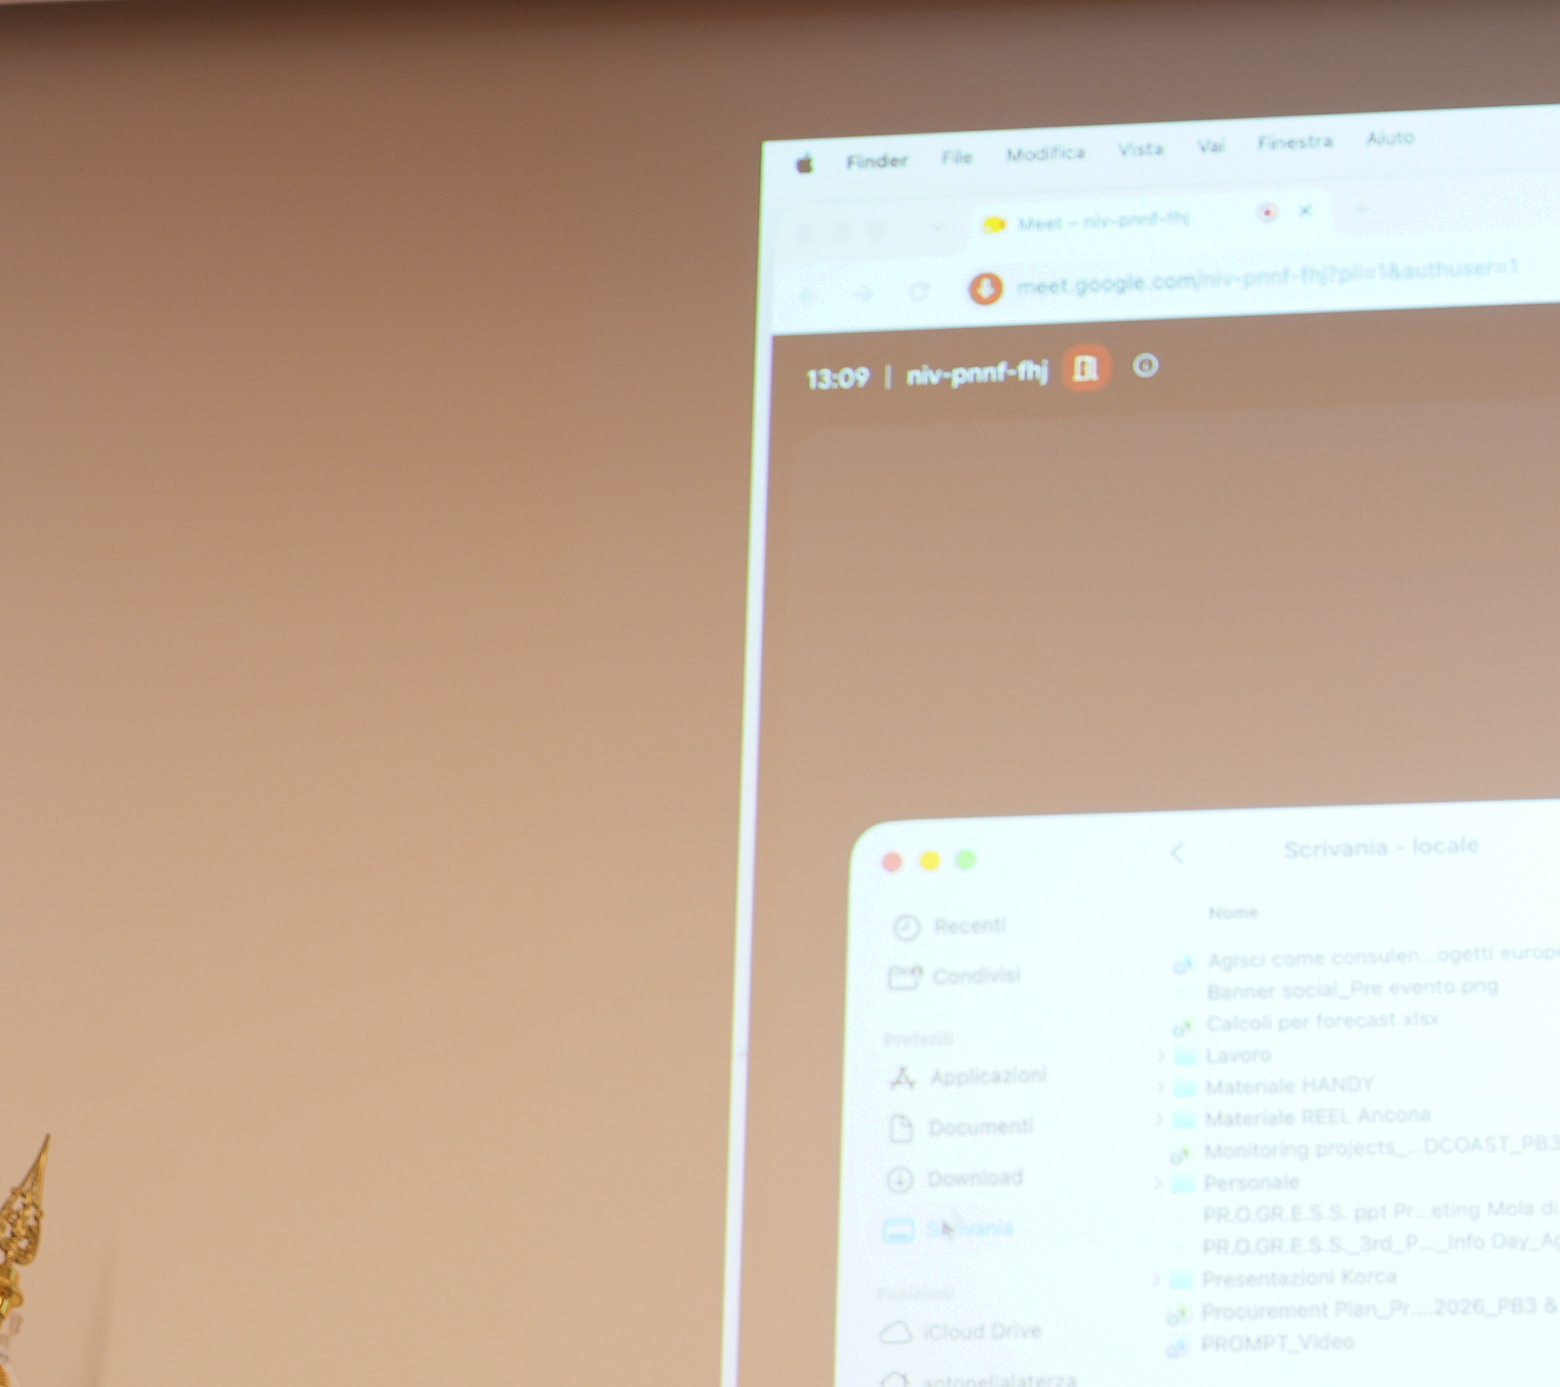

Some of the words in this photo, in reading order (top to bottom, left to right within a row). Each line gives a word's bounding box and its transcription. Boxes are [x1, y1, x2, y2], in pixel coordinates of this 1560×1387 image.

[845, 150, 910, 171] Finder
[940, 148, 974, 167] File
[1005, 142, 1087, 164] Modifica
[1117, 139, 1165, 159] Vista
[1196, 136, 1226, 156] Vai
[1256, 132, 1335, 153] Finestra
[1365, 128, 1416, 148] Aiuto
[806, 365, 870, 391] 13:09
[906, 359, 1050, 388] niv-pnnf-fhj
[1284, 838, 1389, 860] Scrivania
[1411, 835, 1480, 856] locale
[1207, 980, 1276, 1001] Banner
[1282, 977, 1381, 1001] social_Pre
[1386, 975, 1500, 1000] evento.png
[1206, 1011, 1274, 1034] Calcoli
[1281, 1014, 1313, 1034] per
[1319, 1008, 1440, 1031] forecast.xlsx
[1205, 1044, 1272, 1066] Lavoro
[929, 1064, 1048, 1090] Applicazioni
[1205, 1075, 1294, 1098] Materiale
[1300, 1073, 1375, 1095] HANDY
[927, 1115, 1034, 1139] Documenti
[1205, 1108, 1294, 1129] Materiale
[1299, 1106, 1351, 1127] REEL
[1357, 1104, 1432, 1126] Ancona
[927, 1166, 1024, 1190] Download
[1203, 1170, 1300, 1194] Personale
[1202, 1266, 1333, 1291] Presentazioni
[1338, 1266, 1398, 1288] Korca
[923, 1320, 982, 1343] iCloud
[985, 1320, 1043, 1342] Drive
[1201, 1333, 1355, 1356] PROMPT_Video
